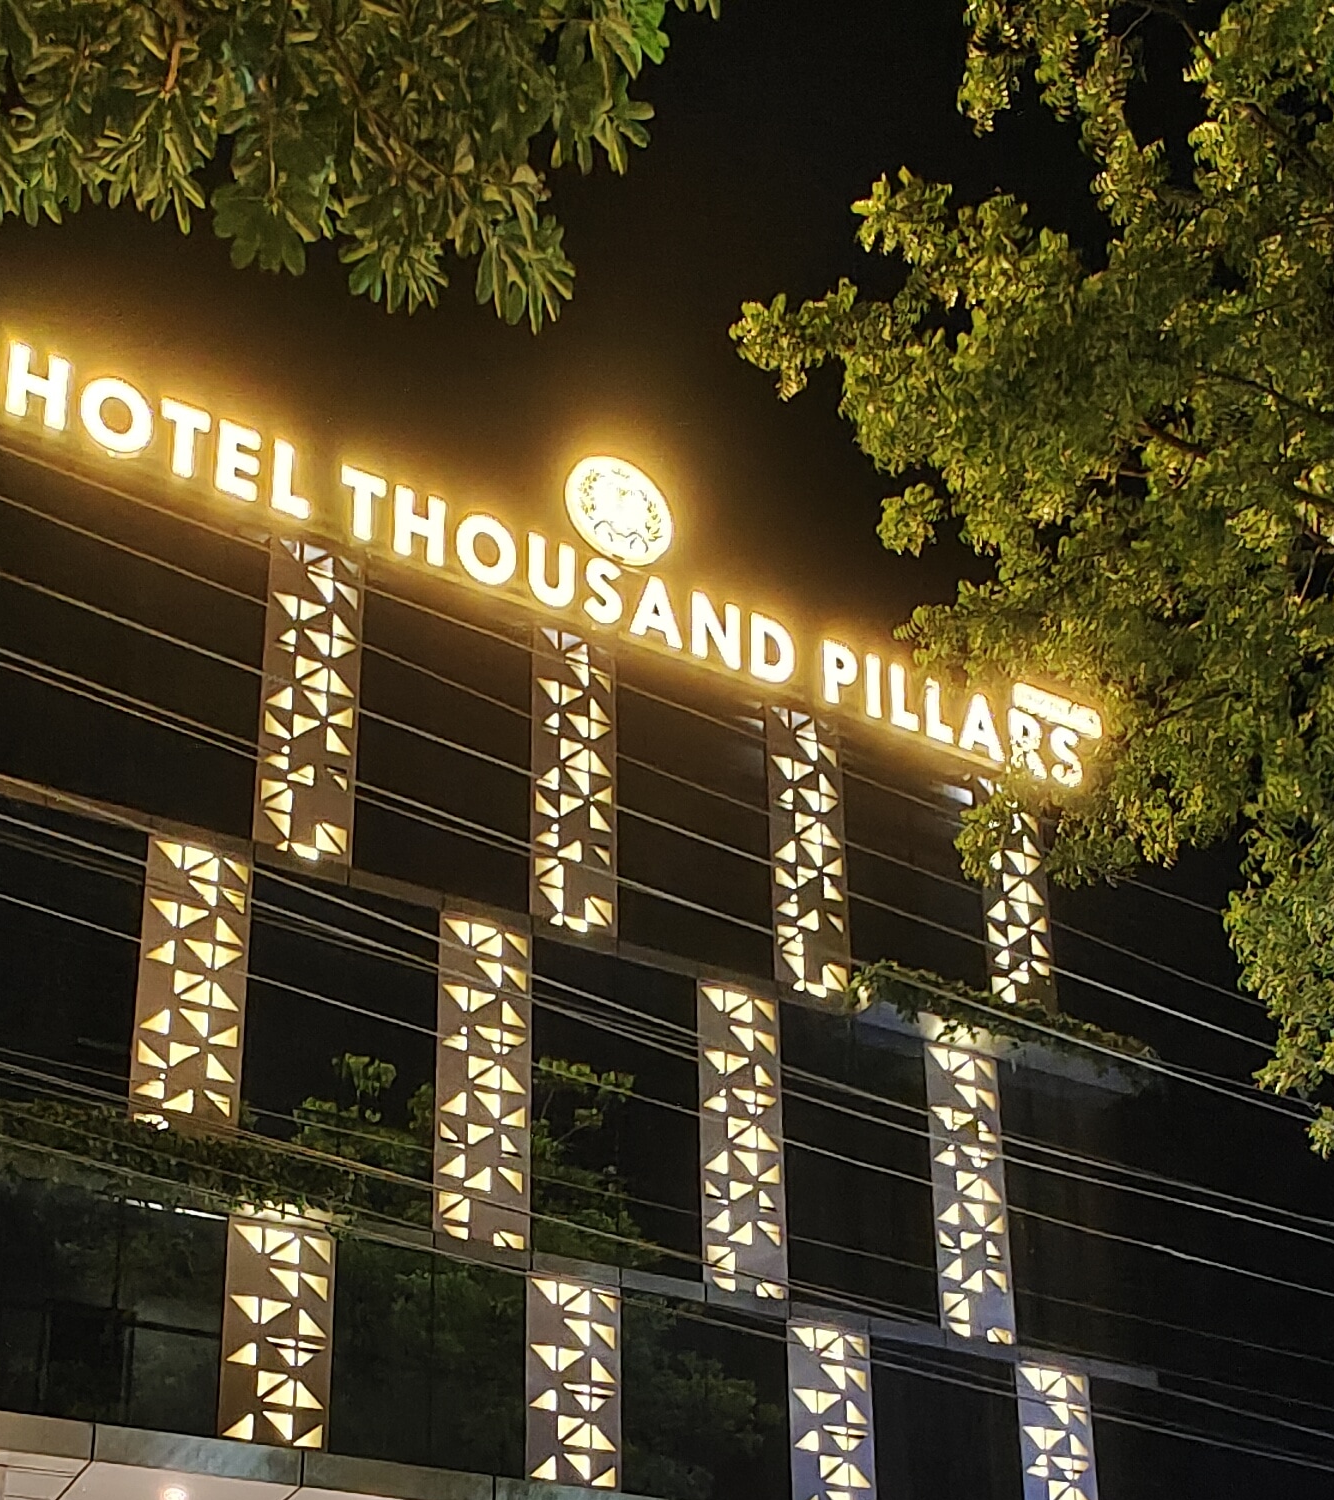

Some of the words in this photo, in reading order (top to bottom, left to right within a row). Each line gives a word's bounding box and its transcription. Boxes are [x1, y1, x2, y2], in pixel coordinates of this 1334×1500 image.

[3, 338, 313, 522] HOTEL
[339, 463, 798, 684] THOUSAND
[821, 636, 1085, 790] PILLARS
